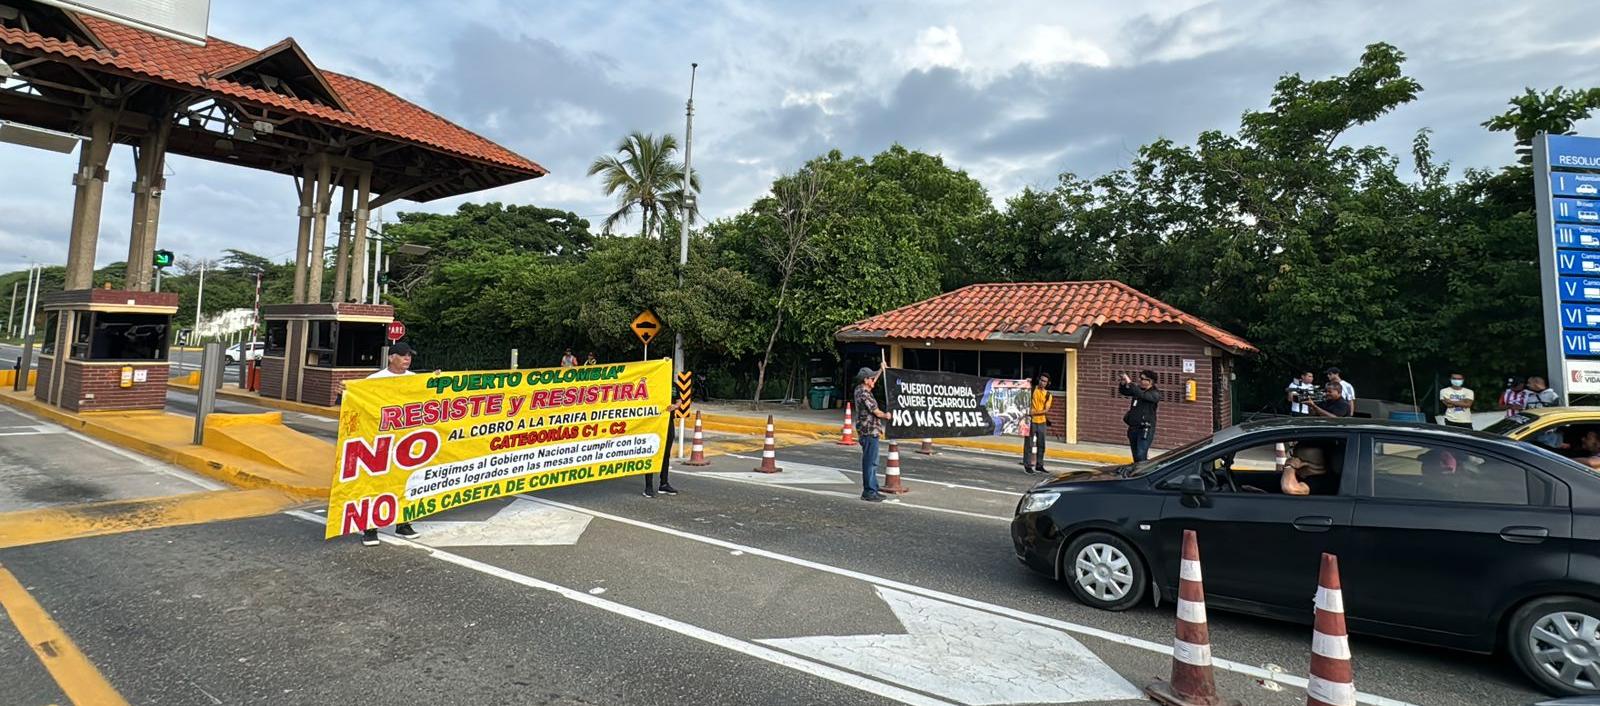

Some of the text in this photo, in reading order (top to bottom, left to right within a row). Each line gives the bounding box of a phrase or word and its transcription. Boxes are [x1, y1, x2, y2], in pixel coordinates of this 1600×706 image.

[1560, 176, 1564, 191] I
[1560, 202, 1568, 217] II
[1560, 228, 1573, 243] III
[1560, 254, 1575, 269] IV
[1565, 281, 1577, 296] V
[1565, 308, 1582, 323] VI
[1566, 335, 1586, 350] VII
[933, 384, 976, 398] COLOMBIA,
[379, 377, 649, 431] RESISTE y RESISTIRÁ
[897, 394, 977, 409] QUIERE DESARROLLO
[448, 406, 662, 441] AL COBRO A LA TARIFA DIFERENCIAL.
[892, 409, 913, 427] NO
[914, 406, 944, 427] MÁS
[490, 425, 579, 451] CATEGORÍAS
[582, 424, 598, 438] C1
[609, 421, 627, 435] C2
[341, 430, 440, 481] NO
[424, 436, 646, 481] Exigimos al Gobierno Nacional cumplir con los
[410, 445, 655, 497] acuerdos logrados en las mesas con la comunidad.
[341, 459, 652, 536] NO MÁS CASETA DE CONTROL PAPIROS
